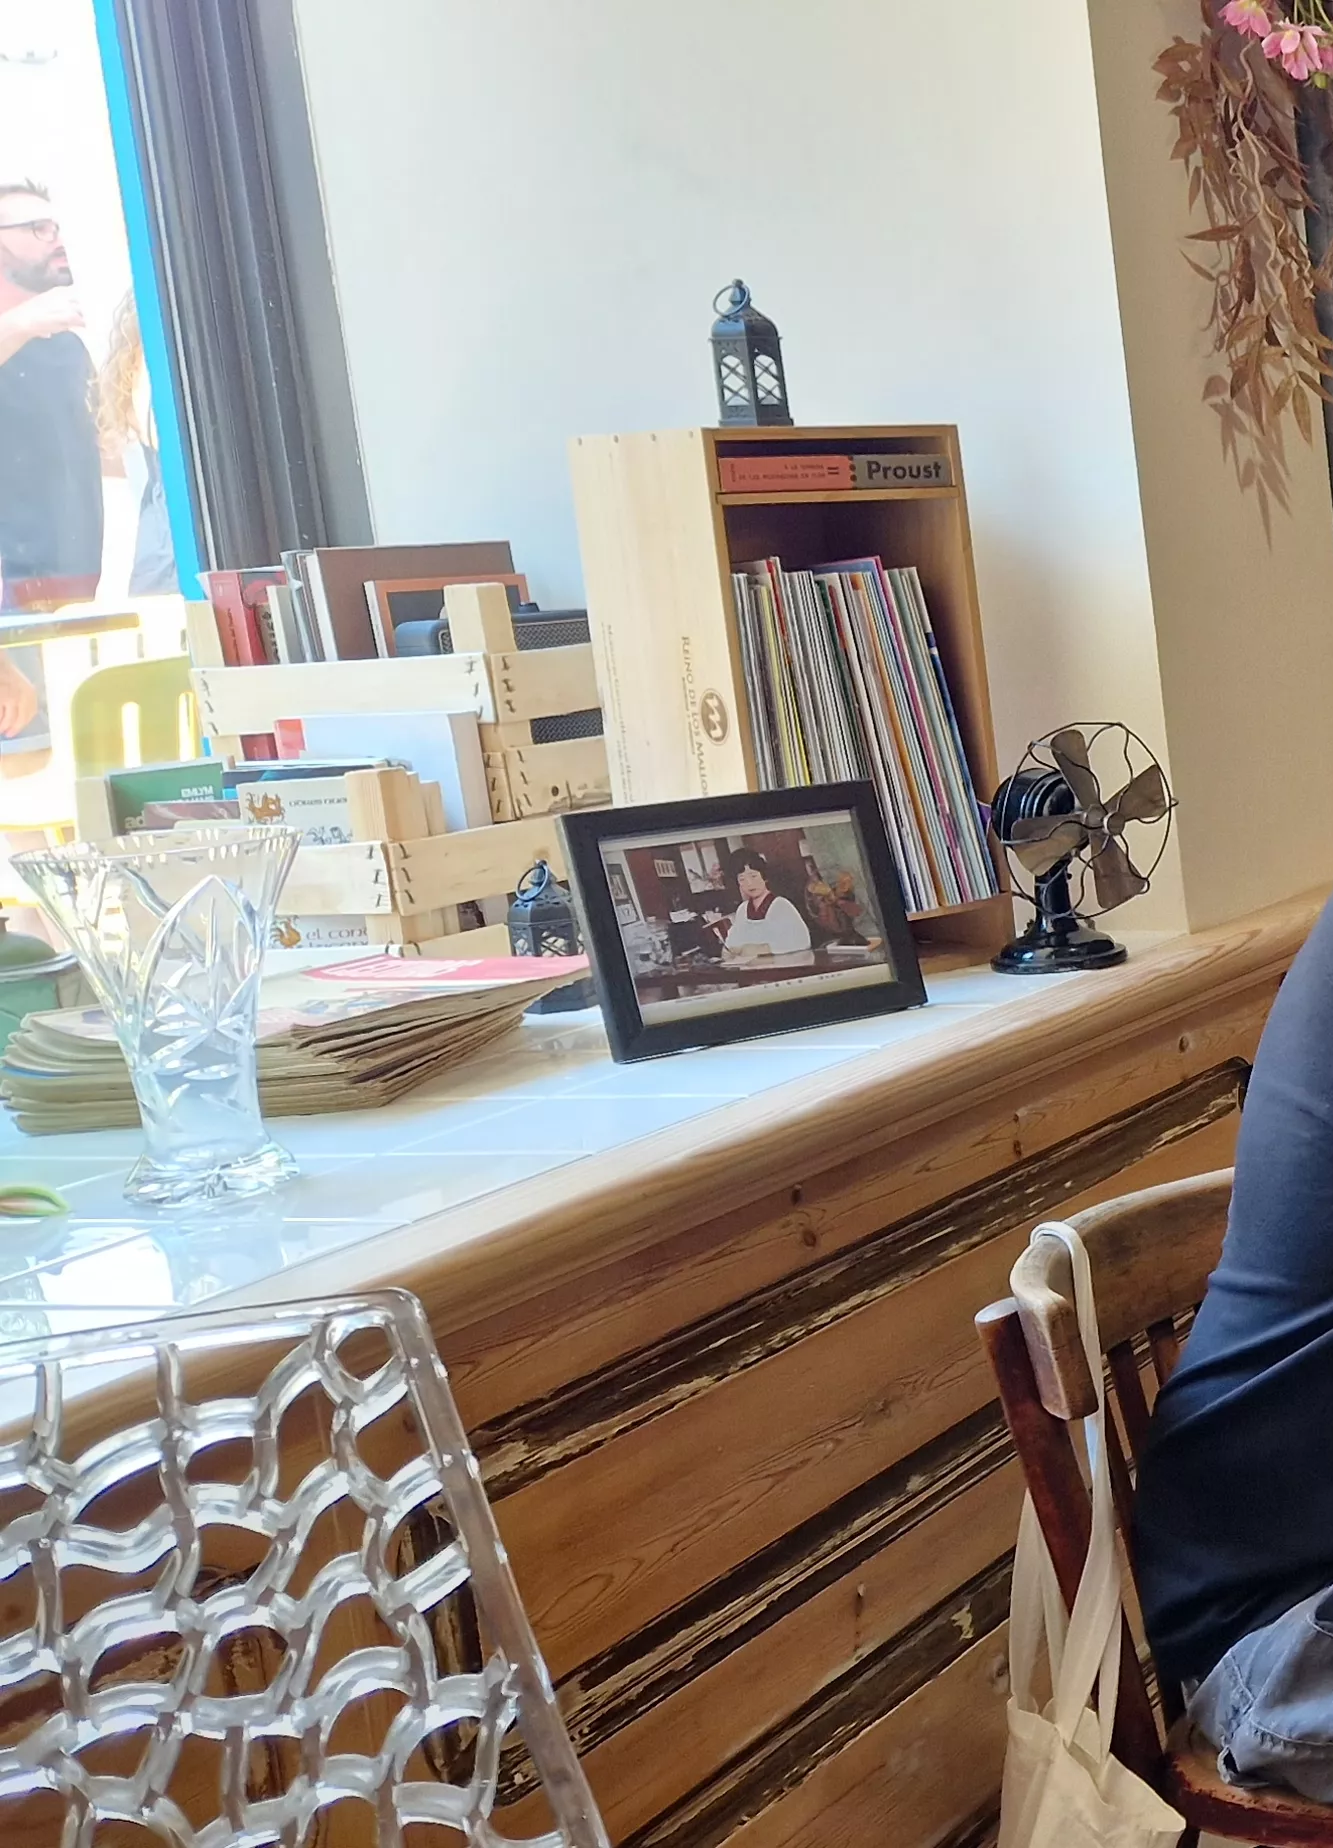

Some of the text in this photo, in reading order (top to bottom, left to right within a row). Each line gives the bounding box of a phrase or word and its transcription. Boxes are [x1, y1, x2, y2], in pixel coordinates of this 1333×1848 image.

[866, 460, 942, 481] Proust
[681, 636, 694, 685] REINO
[688, 689, 698, 711] DE
